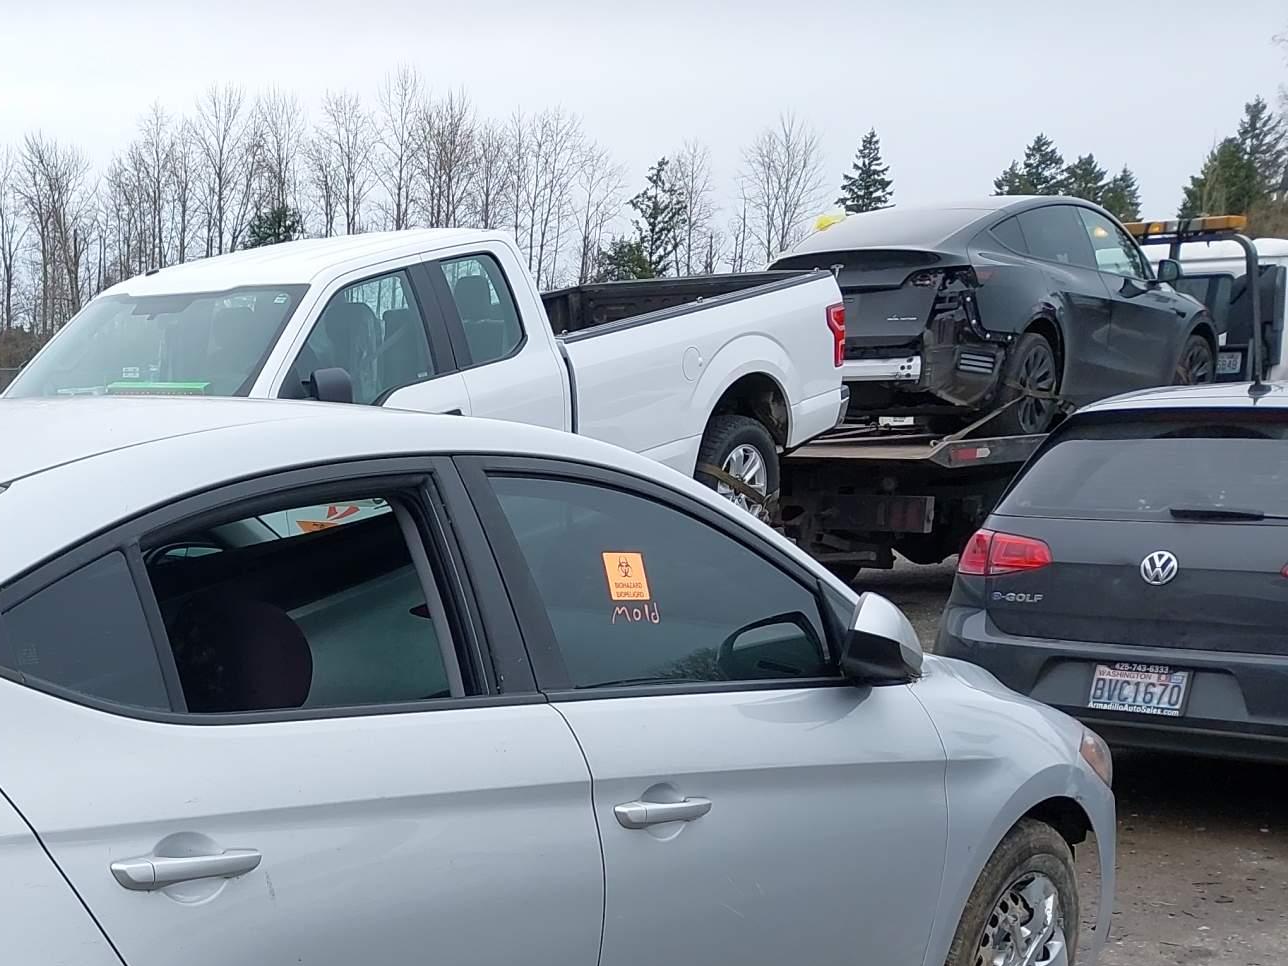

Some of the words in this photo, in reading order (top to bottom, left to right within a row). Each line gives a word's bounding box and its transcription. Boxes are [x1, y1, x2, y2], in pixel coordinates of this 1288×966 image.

[612, 601, 661, 625] Mold
[1098, 669, 1153, 681] WASHINGTON
[1114, 662, 1169, 674] 425-743-6333
[1092, 677, 1183, 707] BVC1670
[1088, 701, 1180, 717] ArmadilloAutoSales.com
